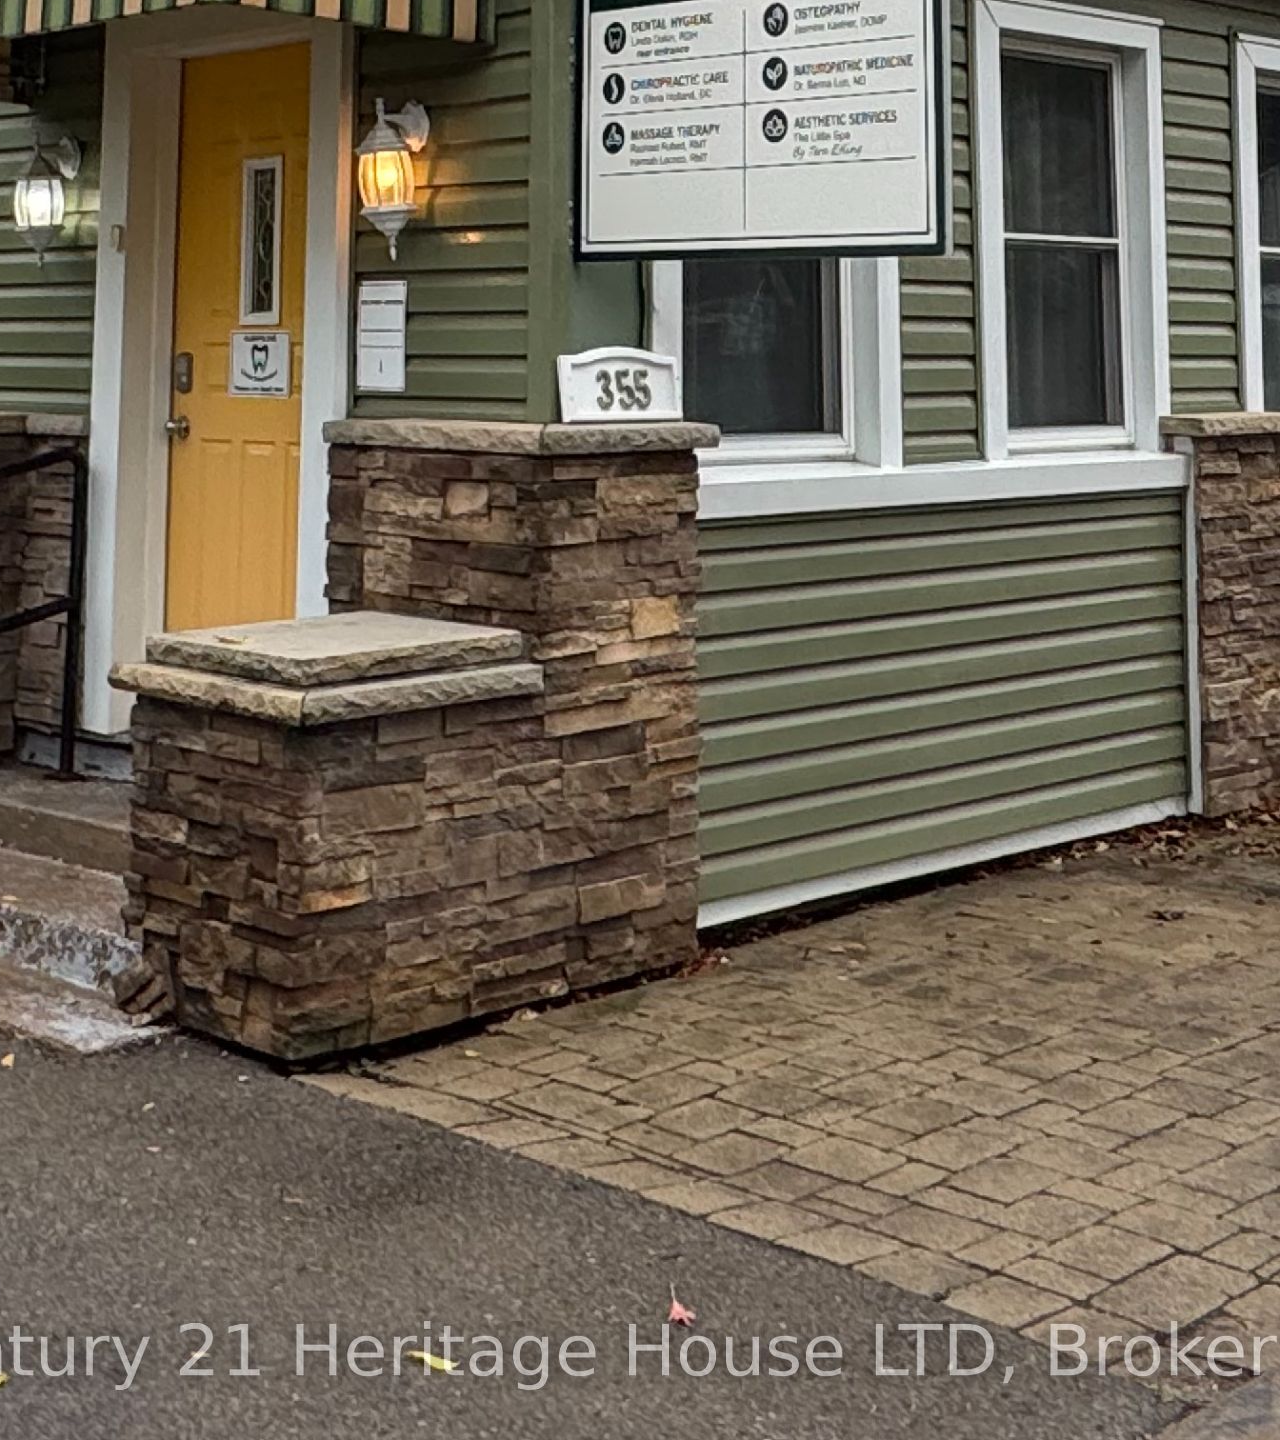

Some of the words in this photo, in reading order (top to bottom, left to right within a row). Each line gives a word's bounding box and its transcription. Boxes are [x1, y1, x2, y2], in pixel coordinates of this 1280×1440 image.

[793, 0, 861, 20] OSTEOPATHY
[630, 18, 667, 34] DENTAL
[670, 12, 714, 29] HYGIENE
[793, 58, 863, 76] NATUROPATHIC
[865, 53, 914, 70] MEDICINE
[630, 73, 701, 91] CHIROPRACTIC
[703, 71, 729, 85] CARE
[793, 115, 847, 129] AESTHETIC
[848, 110, 898, 125] SERVICES
[630, 126, 674, 141] MASSAGE
[676, 123, 721, 137] THERAPY
[793, 131, 809, 142] The
[595, 368, 652, 411] 355
